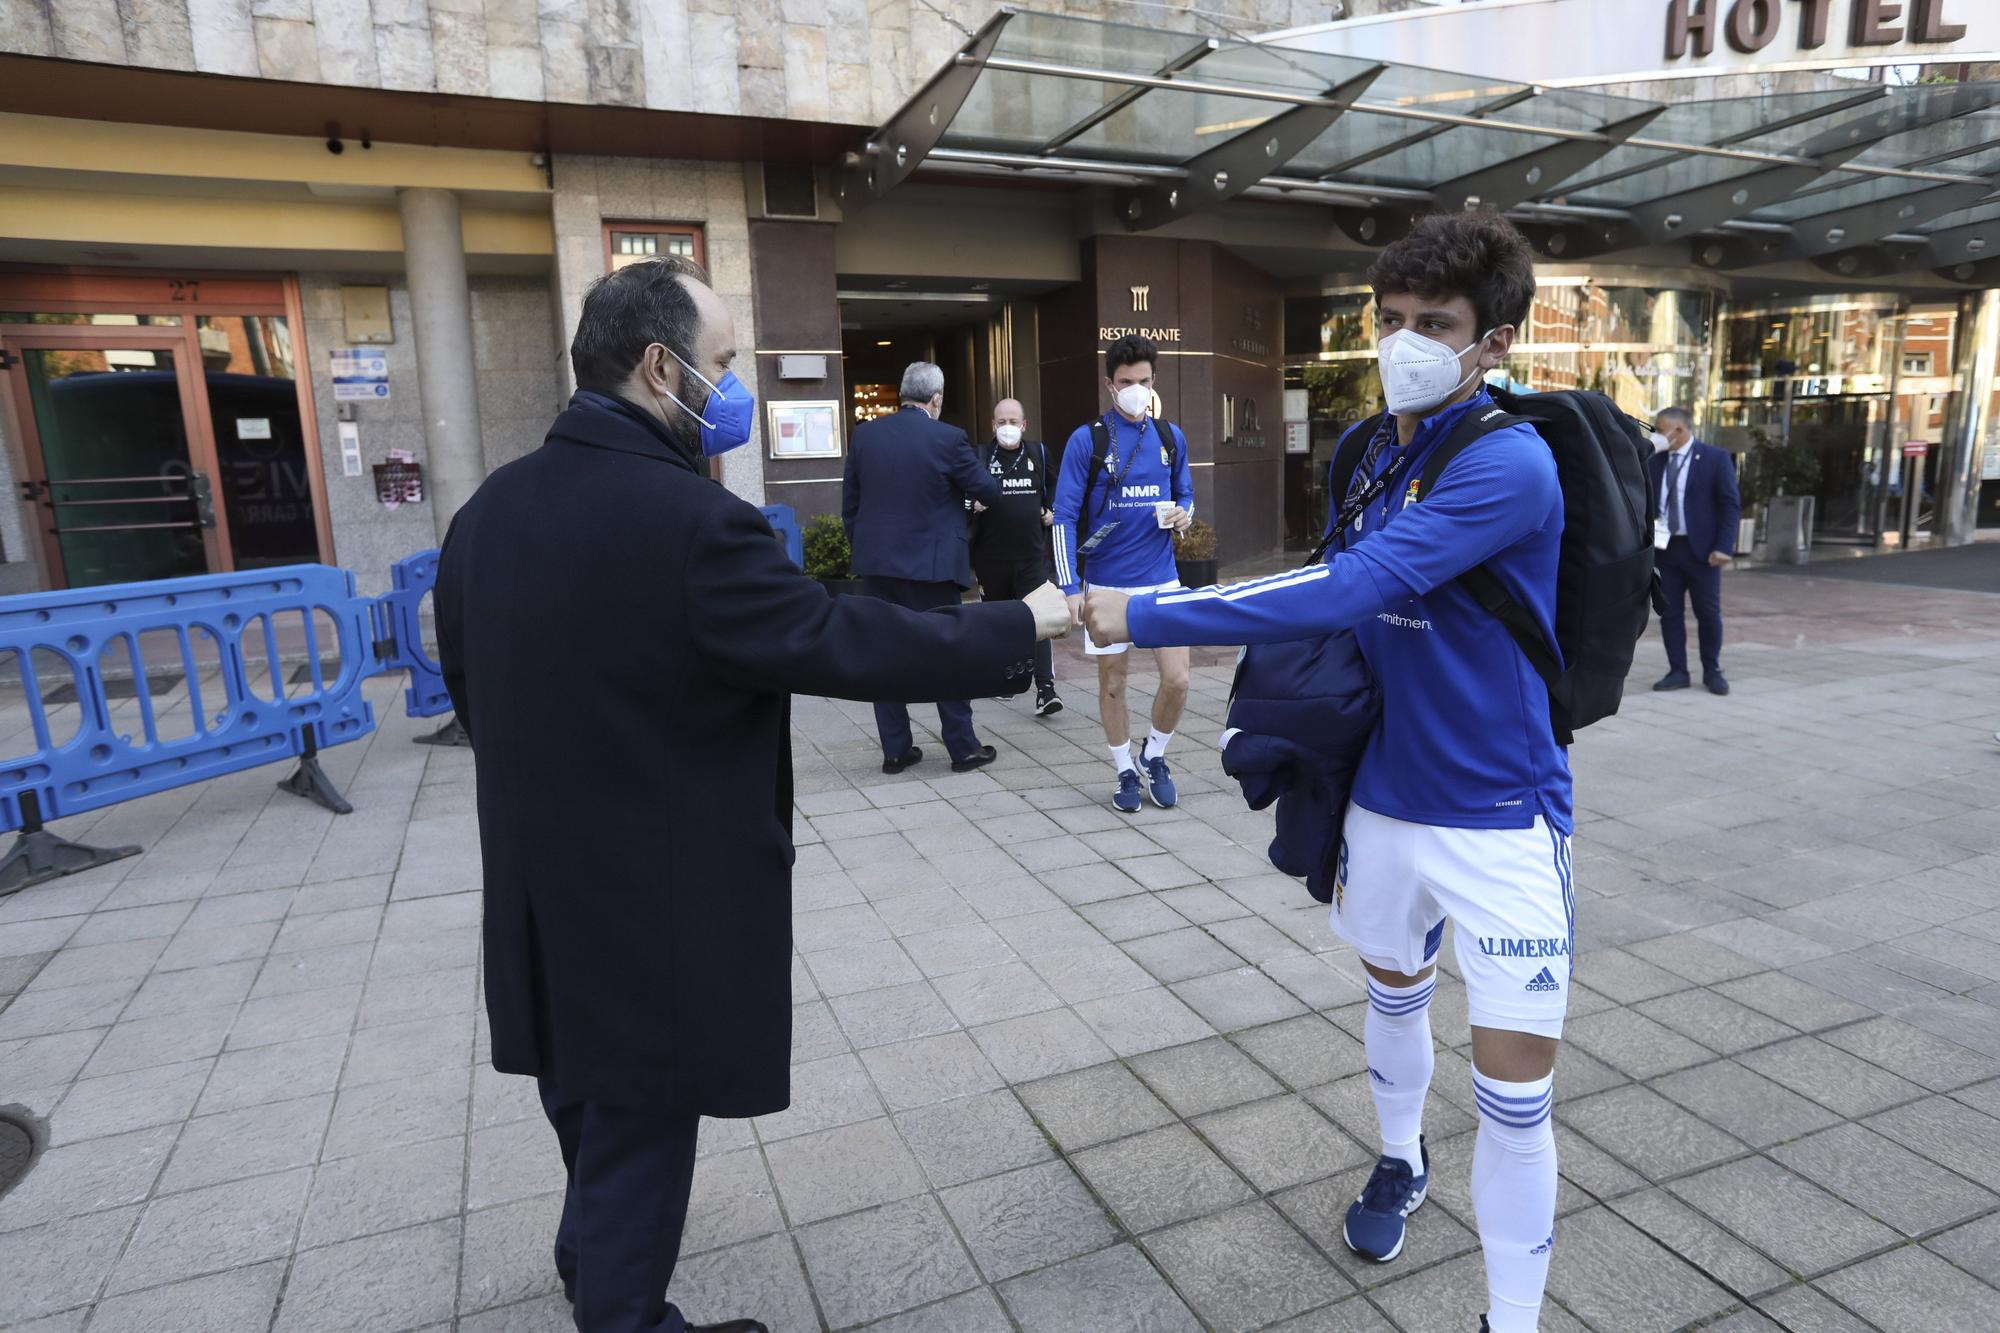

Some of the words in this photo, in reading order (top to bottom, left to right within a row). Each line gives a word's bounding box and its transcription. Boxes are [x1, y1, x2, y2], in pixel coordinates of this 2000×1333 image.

[1664, 0, 1967, 60] HOTEL
[168, 280, 200, 301] 27
[1100, 327, 1180, 341] RESTAURANTE
[1002, 478, 1032, 487] NMR
[1122, 485, 1160, 497] NMR
[1479, 936, 1569, 957] ALIMERKA
[1525, 982, 1560, 992] adidas
